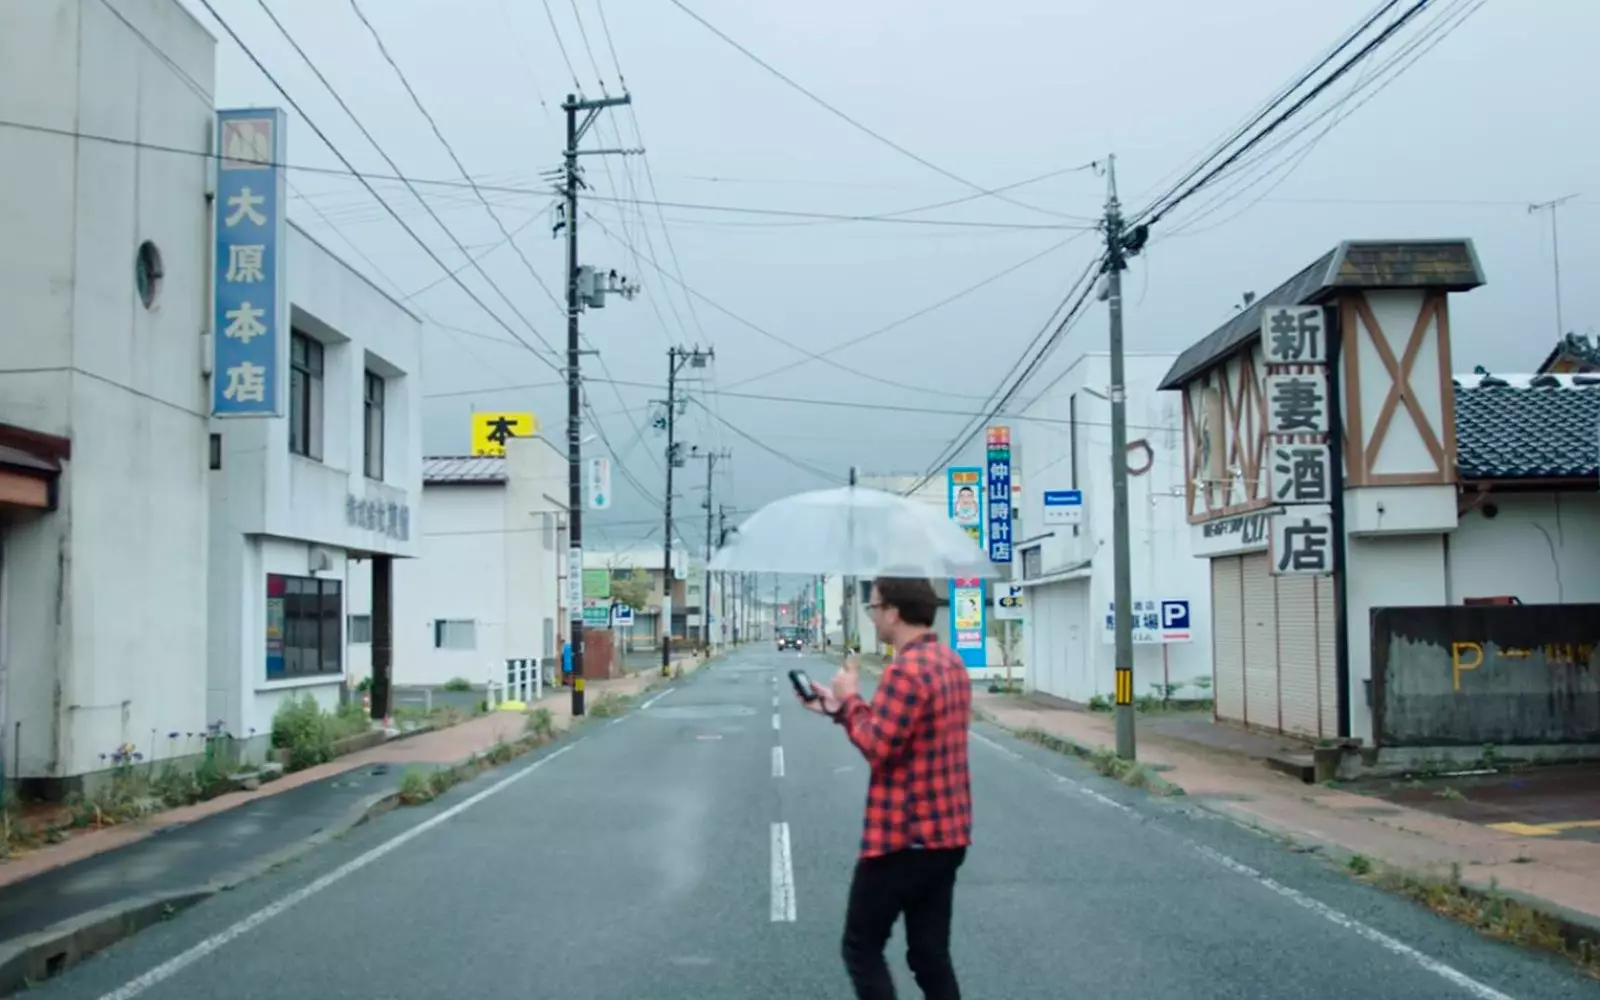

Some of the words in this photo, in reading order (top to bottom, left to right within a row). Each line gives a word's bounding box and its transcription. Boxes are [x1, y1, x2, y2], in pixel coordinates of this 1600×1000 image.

[224, 186, 267, 402] 大原本店
[1270, 309, 1329, 571] 新妻酒店
[990, 462, 1011, 560] 仲山時計店
[1164, 603, 1186, 626] P
[1452, 641, 1484, 691] P
